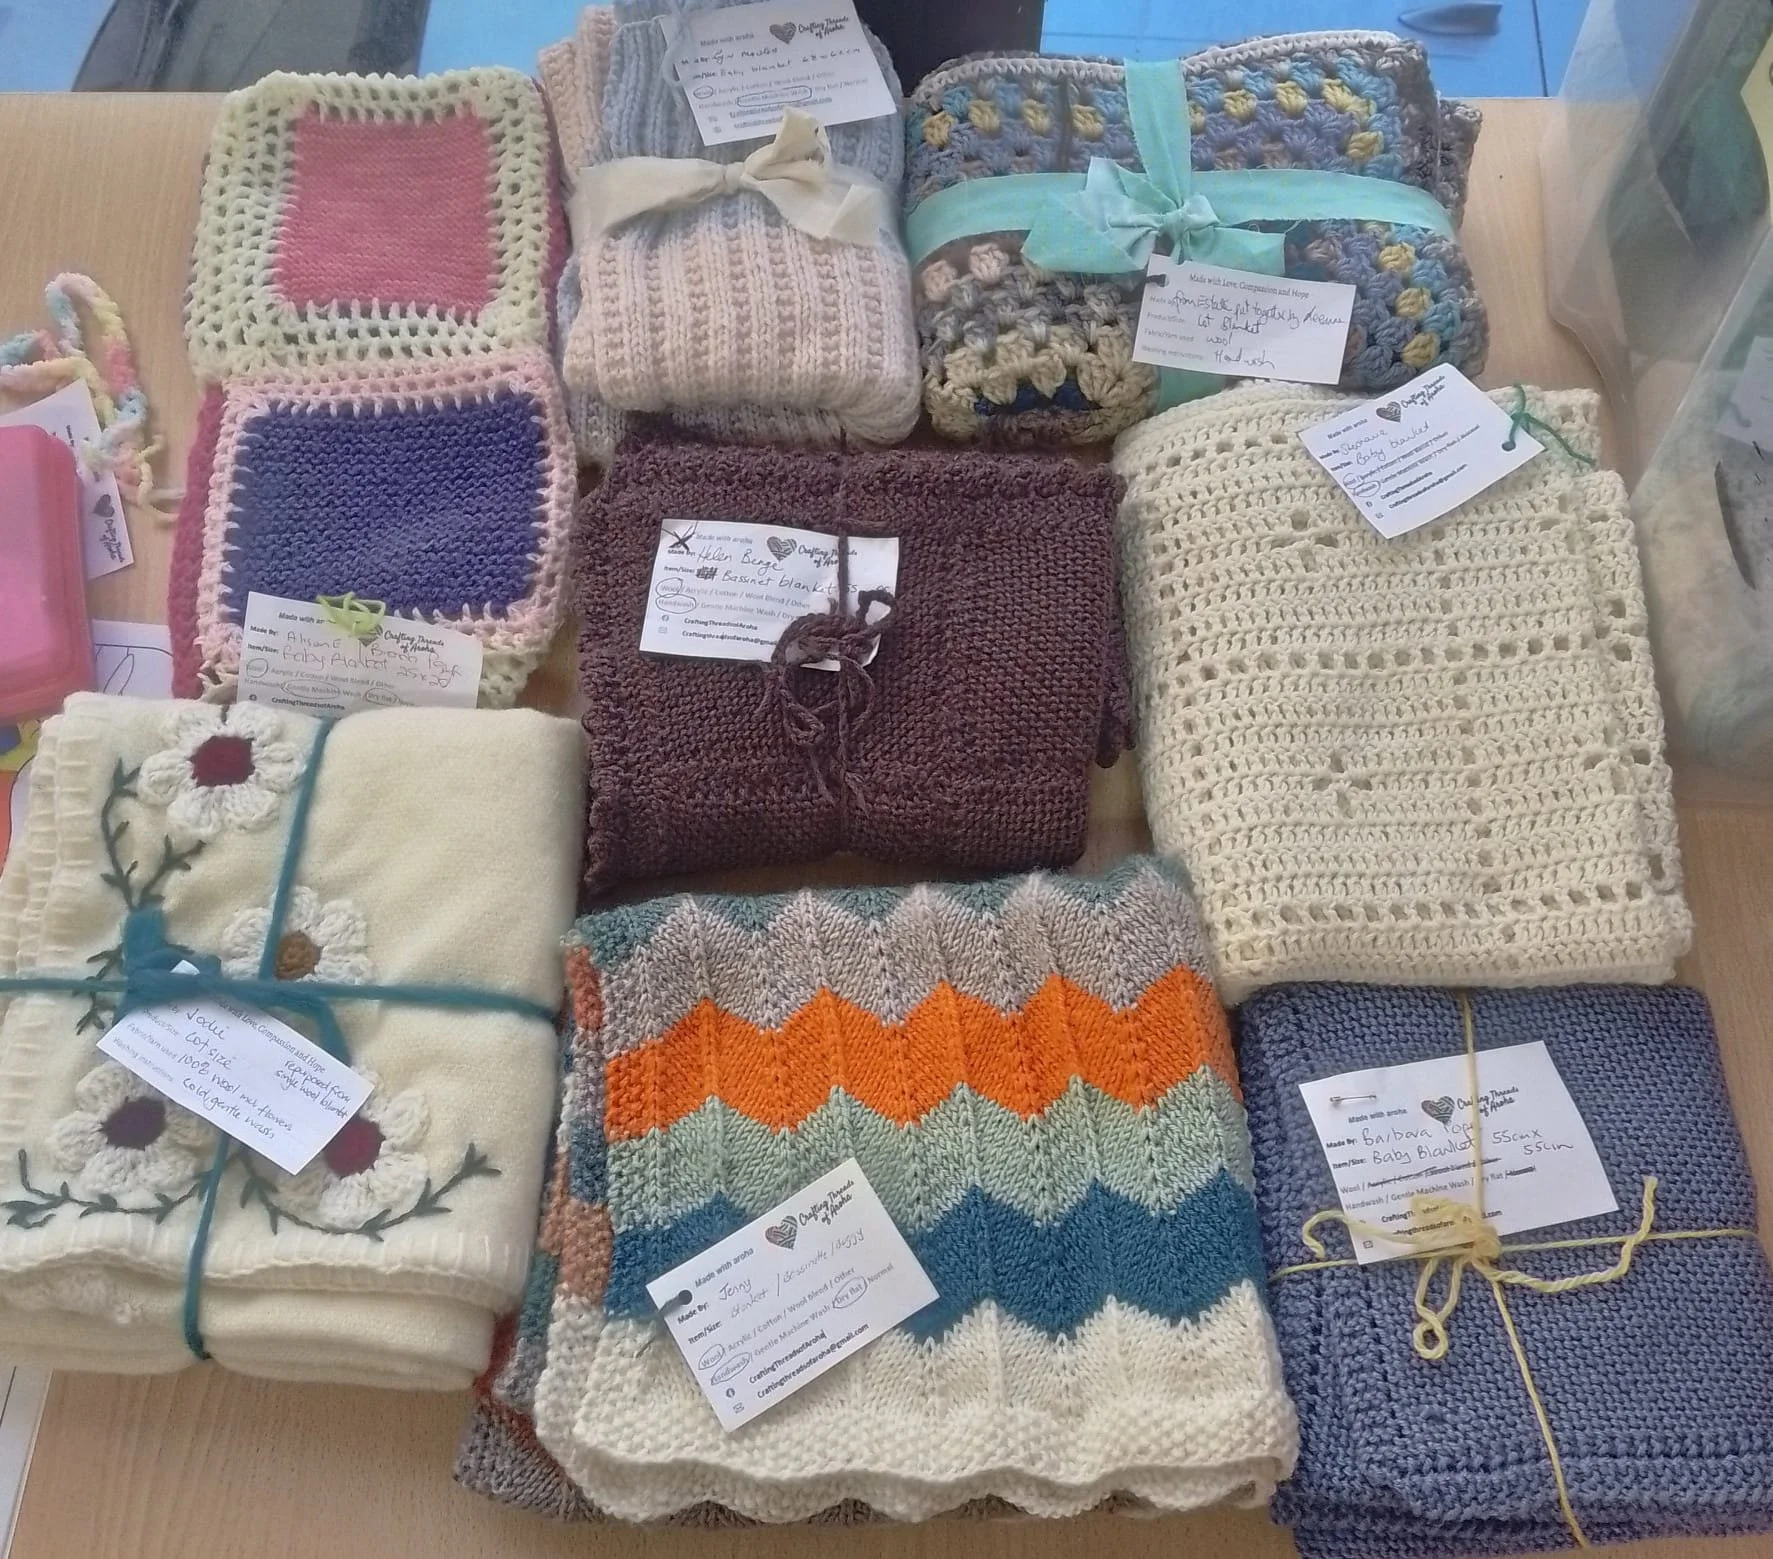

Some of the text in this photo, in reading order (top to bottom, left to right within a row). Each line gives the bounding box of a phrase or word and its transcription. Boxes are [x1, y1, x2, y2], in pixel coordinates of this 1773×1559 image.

[1190, 273, 1206, 282] Made
[1208, 276, 1222, 285] with
[1292, 289, 1310, 299] Hope
[698, 544, 732, 564] Helen
[798, 544, 829, 559] Crafting
[721, 570, 774, 586] Bassinet
[278, 612, 298, 621] Made
[299, 616, 314, 624] with
[250, 626, 268, 634] Made
[384, 630, 444, 646] Crafting Threads
[400, 643, 408, 654] of
[258, 1024, 296, 1054] Compassion
[294, 1048, 310, 1063] and
[306, 1056, 326, 1074] Hope
[1490, 1086, 1520, 1100] Threads
[1348, 1108, 1408, 1124] Made with aroha
[1479, 1096, 1516, 1118] of Aroha
[1326, 1140, 1346, 1148] Made
[1362, 1128, 1432, 1146] Barbara
[1372, 1148, 1412, 1165] Baby
[1416, 1139, 1475, 1160] Blanket
[1340, 1186, 1360, 1194] Wool
[1345, 1197, 1384, 1211] Handwash
[1391, 1190, 1415, 1201] Gentle
[1416, 1184, 1448, 1196] Machine
[1448, 1180, 1470, 1190] Wash
[798, 1180, 855, 1226] Crafting Threads
[821, 1193, 852, 1226] of Aroha
[694, 1248, 754, 1288] Made with aroha
[677, 1279, 752, 1324] Made By: Jenny
[754, 1338, 779, 1356] Gentle
[778, 1319, 810, 1342] Machine
[810, 1304, 830, 1320] Wash
[836, 1293, 850, 1306] Dry
[850, 1283, 863, 1296] flat
[868, 1262, 894, 1284] Normal
[701, 1350, 722, 1368] Wool
[728, 1334, 753, 1352] Acrylic
[756, 1314, 782, 1332] Cotton
[787, 1298, 808, 1314] Wool
[834, 1267, 856, 1284] Other
[688, 1320, 722, 1344] Item/Size:
[757, 1324, 869, 1398] Craftingthreadsofaroha@gmail.com
